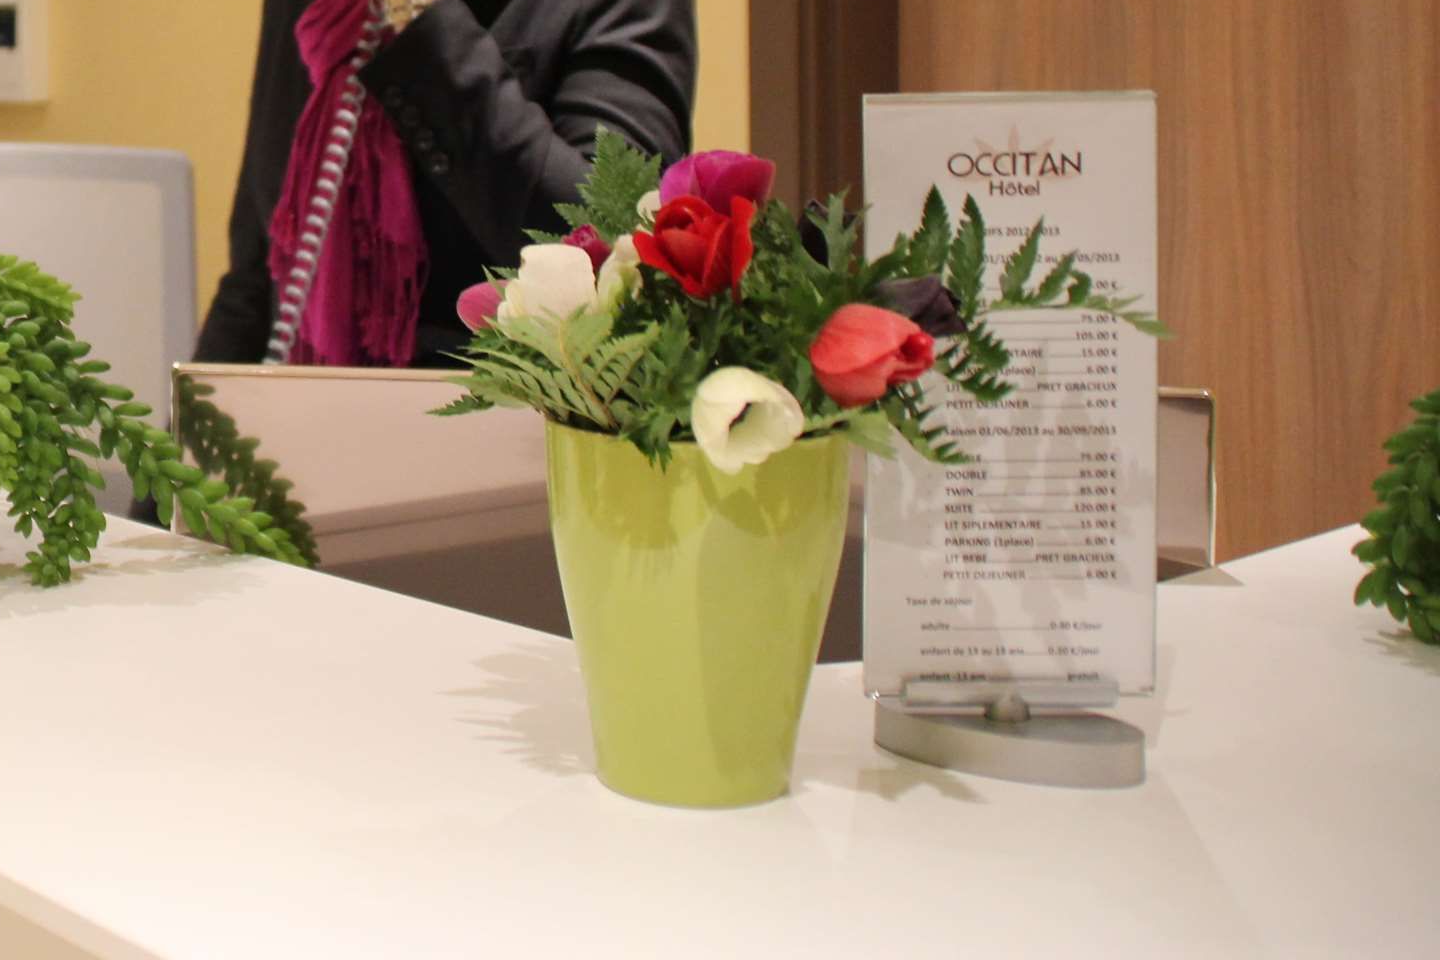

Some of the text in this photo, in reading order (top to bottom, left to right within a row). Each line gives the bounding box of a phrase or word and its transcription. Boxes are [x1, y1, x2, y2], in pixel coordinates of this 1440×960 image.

[946, 151, 1083, 177] OCCITAN
[988, 180, 1040, 197] Hôtel
[1064, 382, 1118, 392] GRACIEUX
[945, 399, 973, 409] PETIT
[945, 470, 987, 480] DOUBLE
[945, 487, 974, 496] TWIN
[944, 503, 973, 513] SUITE
[944, 537, 991, 546] PARKING
